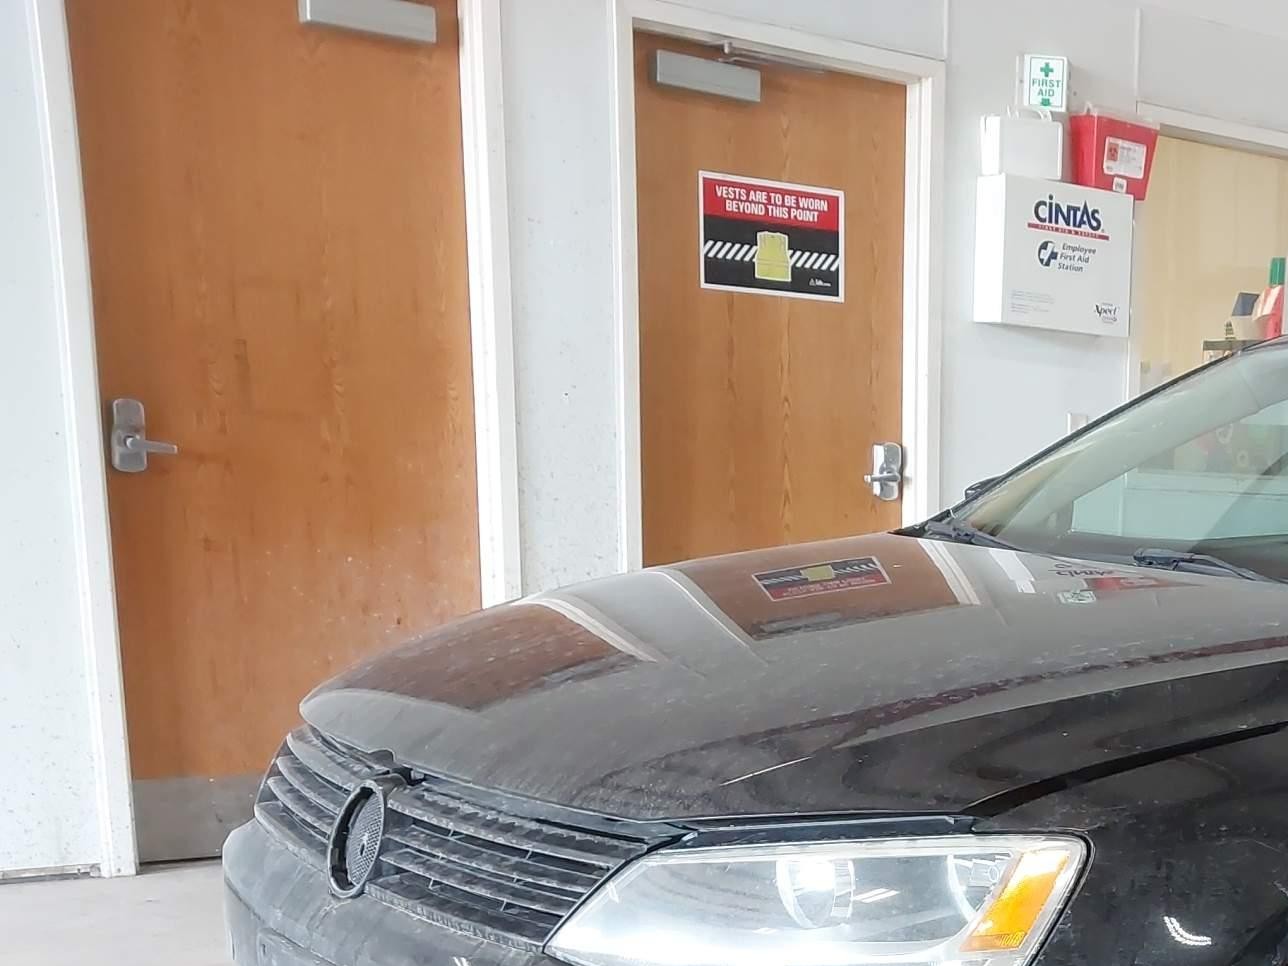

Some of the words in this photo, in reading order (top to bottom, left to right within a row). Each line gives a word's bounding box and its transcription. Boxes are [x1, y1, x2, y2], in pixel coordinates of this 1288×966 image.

[1031, 78, 1061, 88] FIRST
[1037, 88, 1055, 97] AID
[716, 185, 746, 200] VESTS
[748, 191, 767, 203] ARE
[769, 192, 782, 205] TO
[784, 195, 797, 207] BE
[798, 197, 828, 212] WORN
[725, 200, 765, 216] BEYOND
[767, 205, 788, 219] THIS
[790, 208, 819, 222] POINT
[1033, 193, 1102, 232] CINTAS
[1061, 243, 1097, 255] Employee
[1060, 252, 1076, 262] First
[1076, 255, 1090, 264] Aid
[1057, 262, 1084, 273] Station
